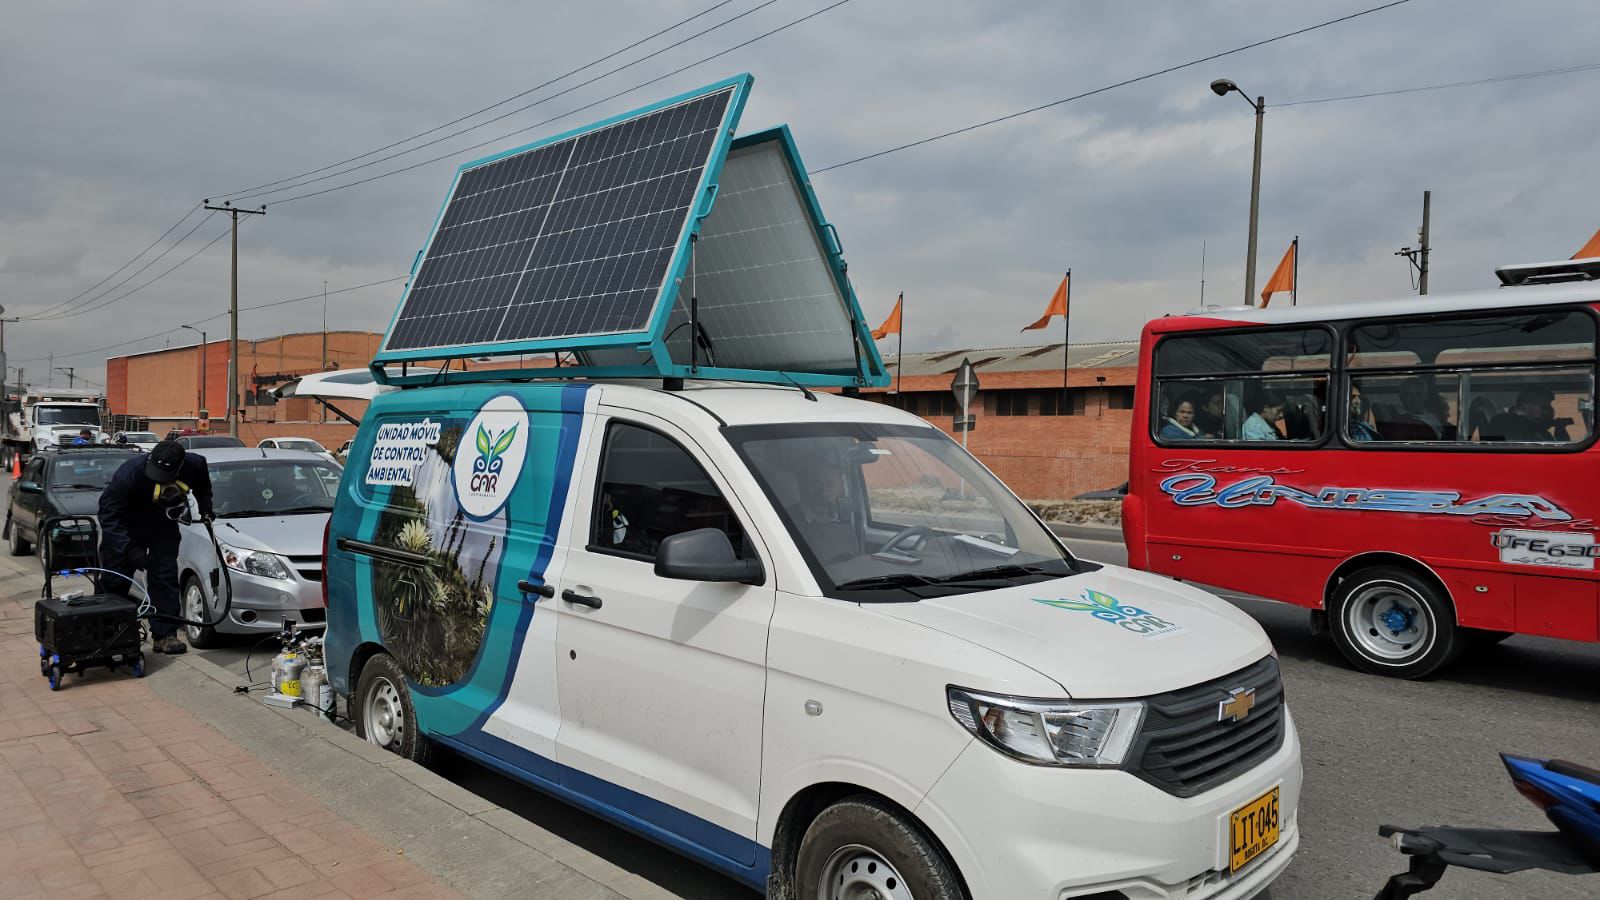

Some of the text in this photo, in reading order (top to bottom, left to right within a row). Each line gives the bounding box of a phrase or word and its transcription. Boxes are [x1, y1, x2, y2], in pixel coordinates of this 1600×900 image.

[378, 422, 438, 440] UNIDAD MÓVIL
[373, 447, 424, 461] DE CONTROL
[1152, 458, 1306, 473] Trans
[367, 467, 412, 482] AMBIENTAL
[470, 473, 498, 493] CAR
[1119, 616, 1176, 633] CAR
